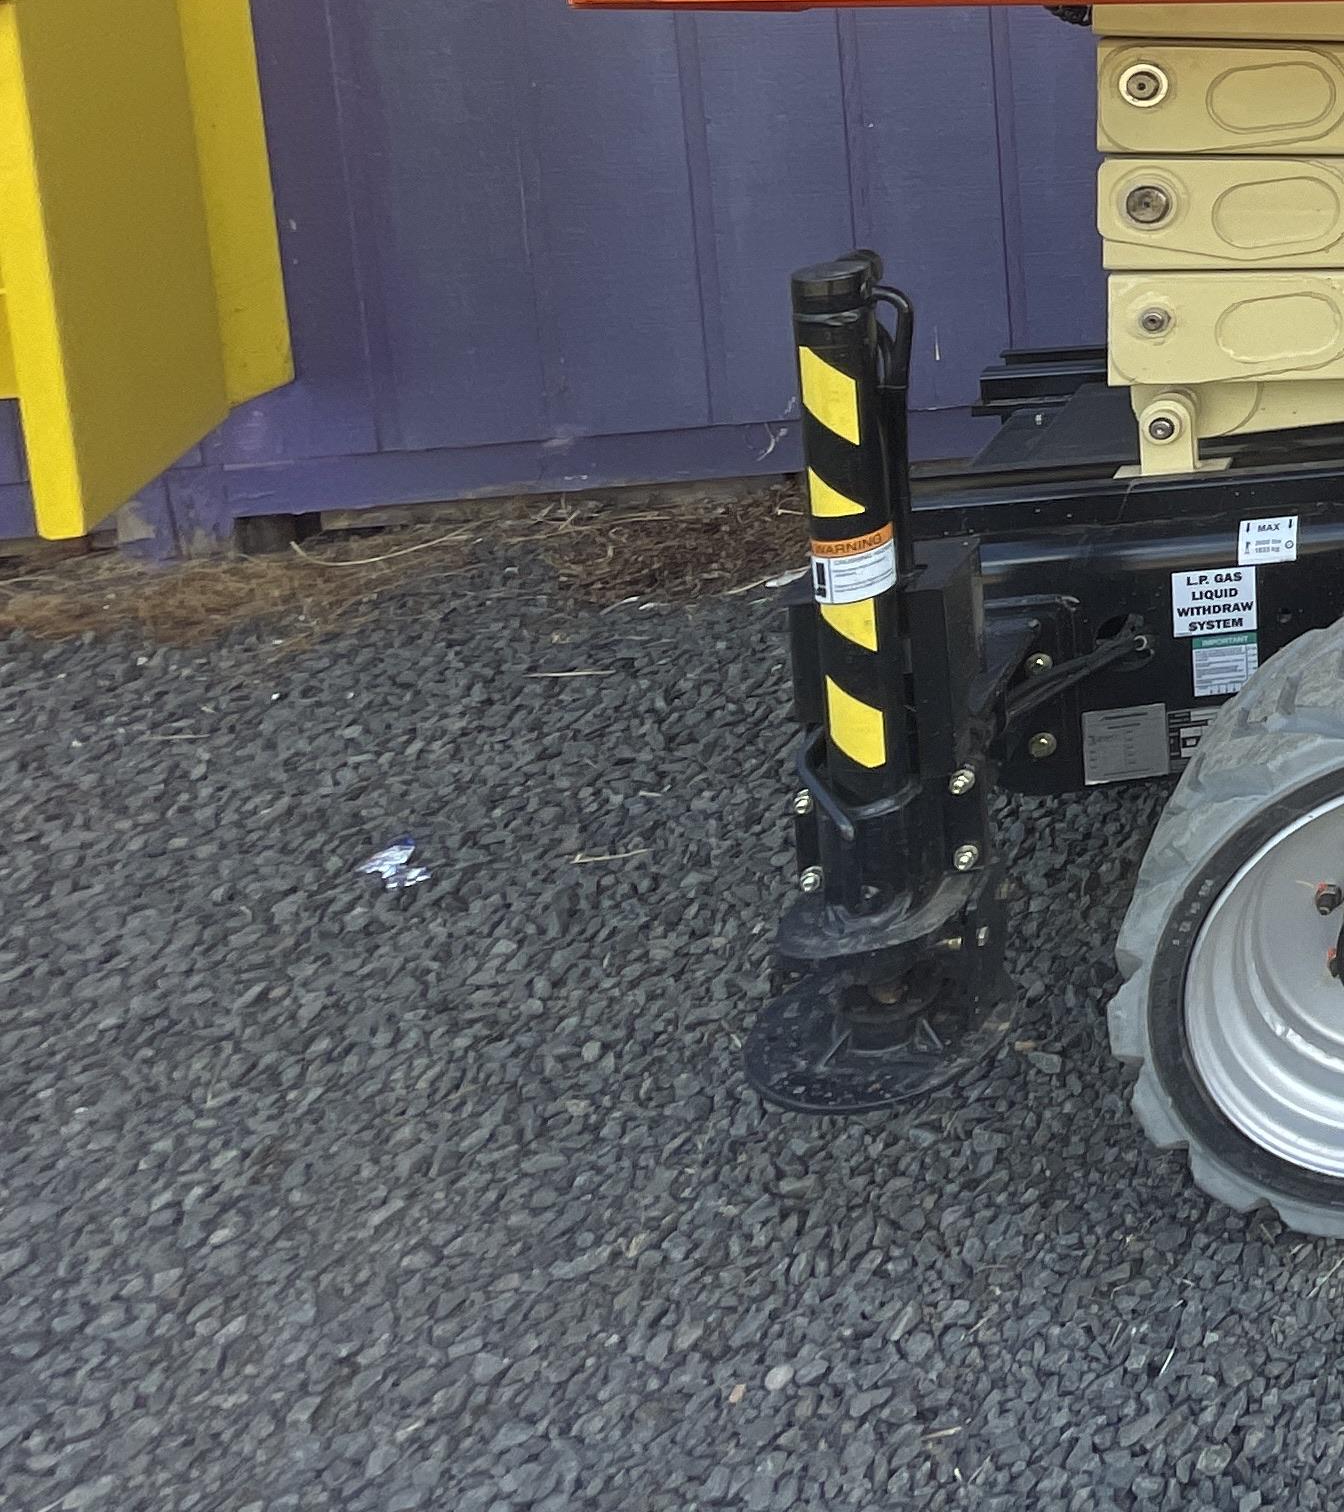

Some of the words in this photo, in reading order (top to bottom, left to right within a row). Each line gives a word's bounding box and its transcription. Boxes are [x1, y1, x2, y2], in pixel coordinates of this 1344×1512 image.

[1257, 523, 1281, 533] MAX
[815, 532, 882, 554] WARNING
[1186, 575, 1209, 586] L.P.
[1214, 572, 1242, 583] GAS
[1191, 587, 1239, 601] LIQUID
[1177, 601, 1254, 617] WITHDRAW
[1188, 618, 1244, 631] SYSTEM
[1201, 635, 1248, 647] IMPORTANT
